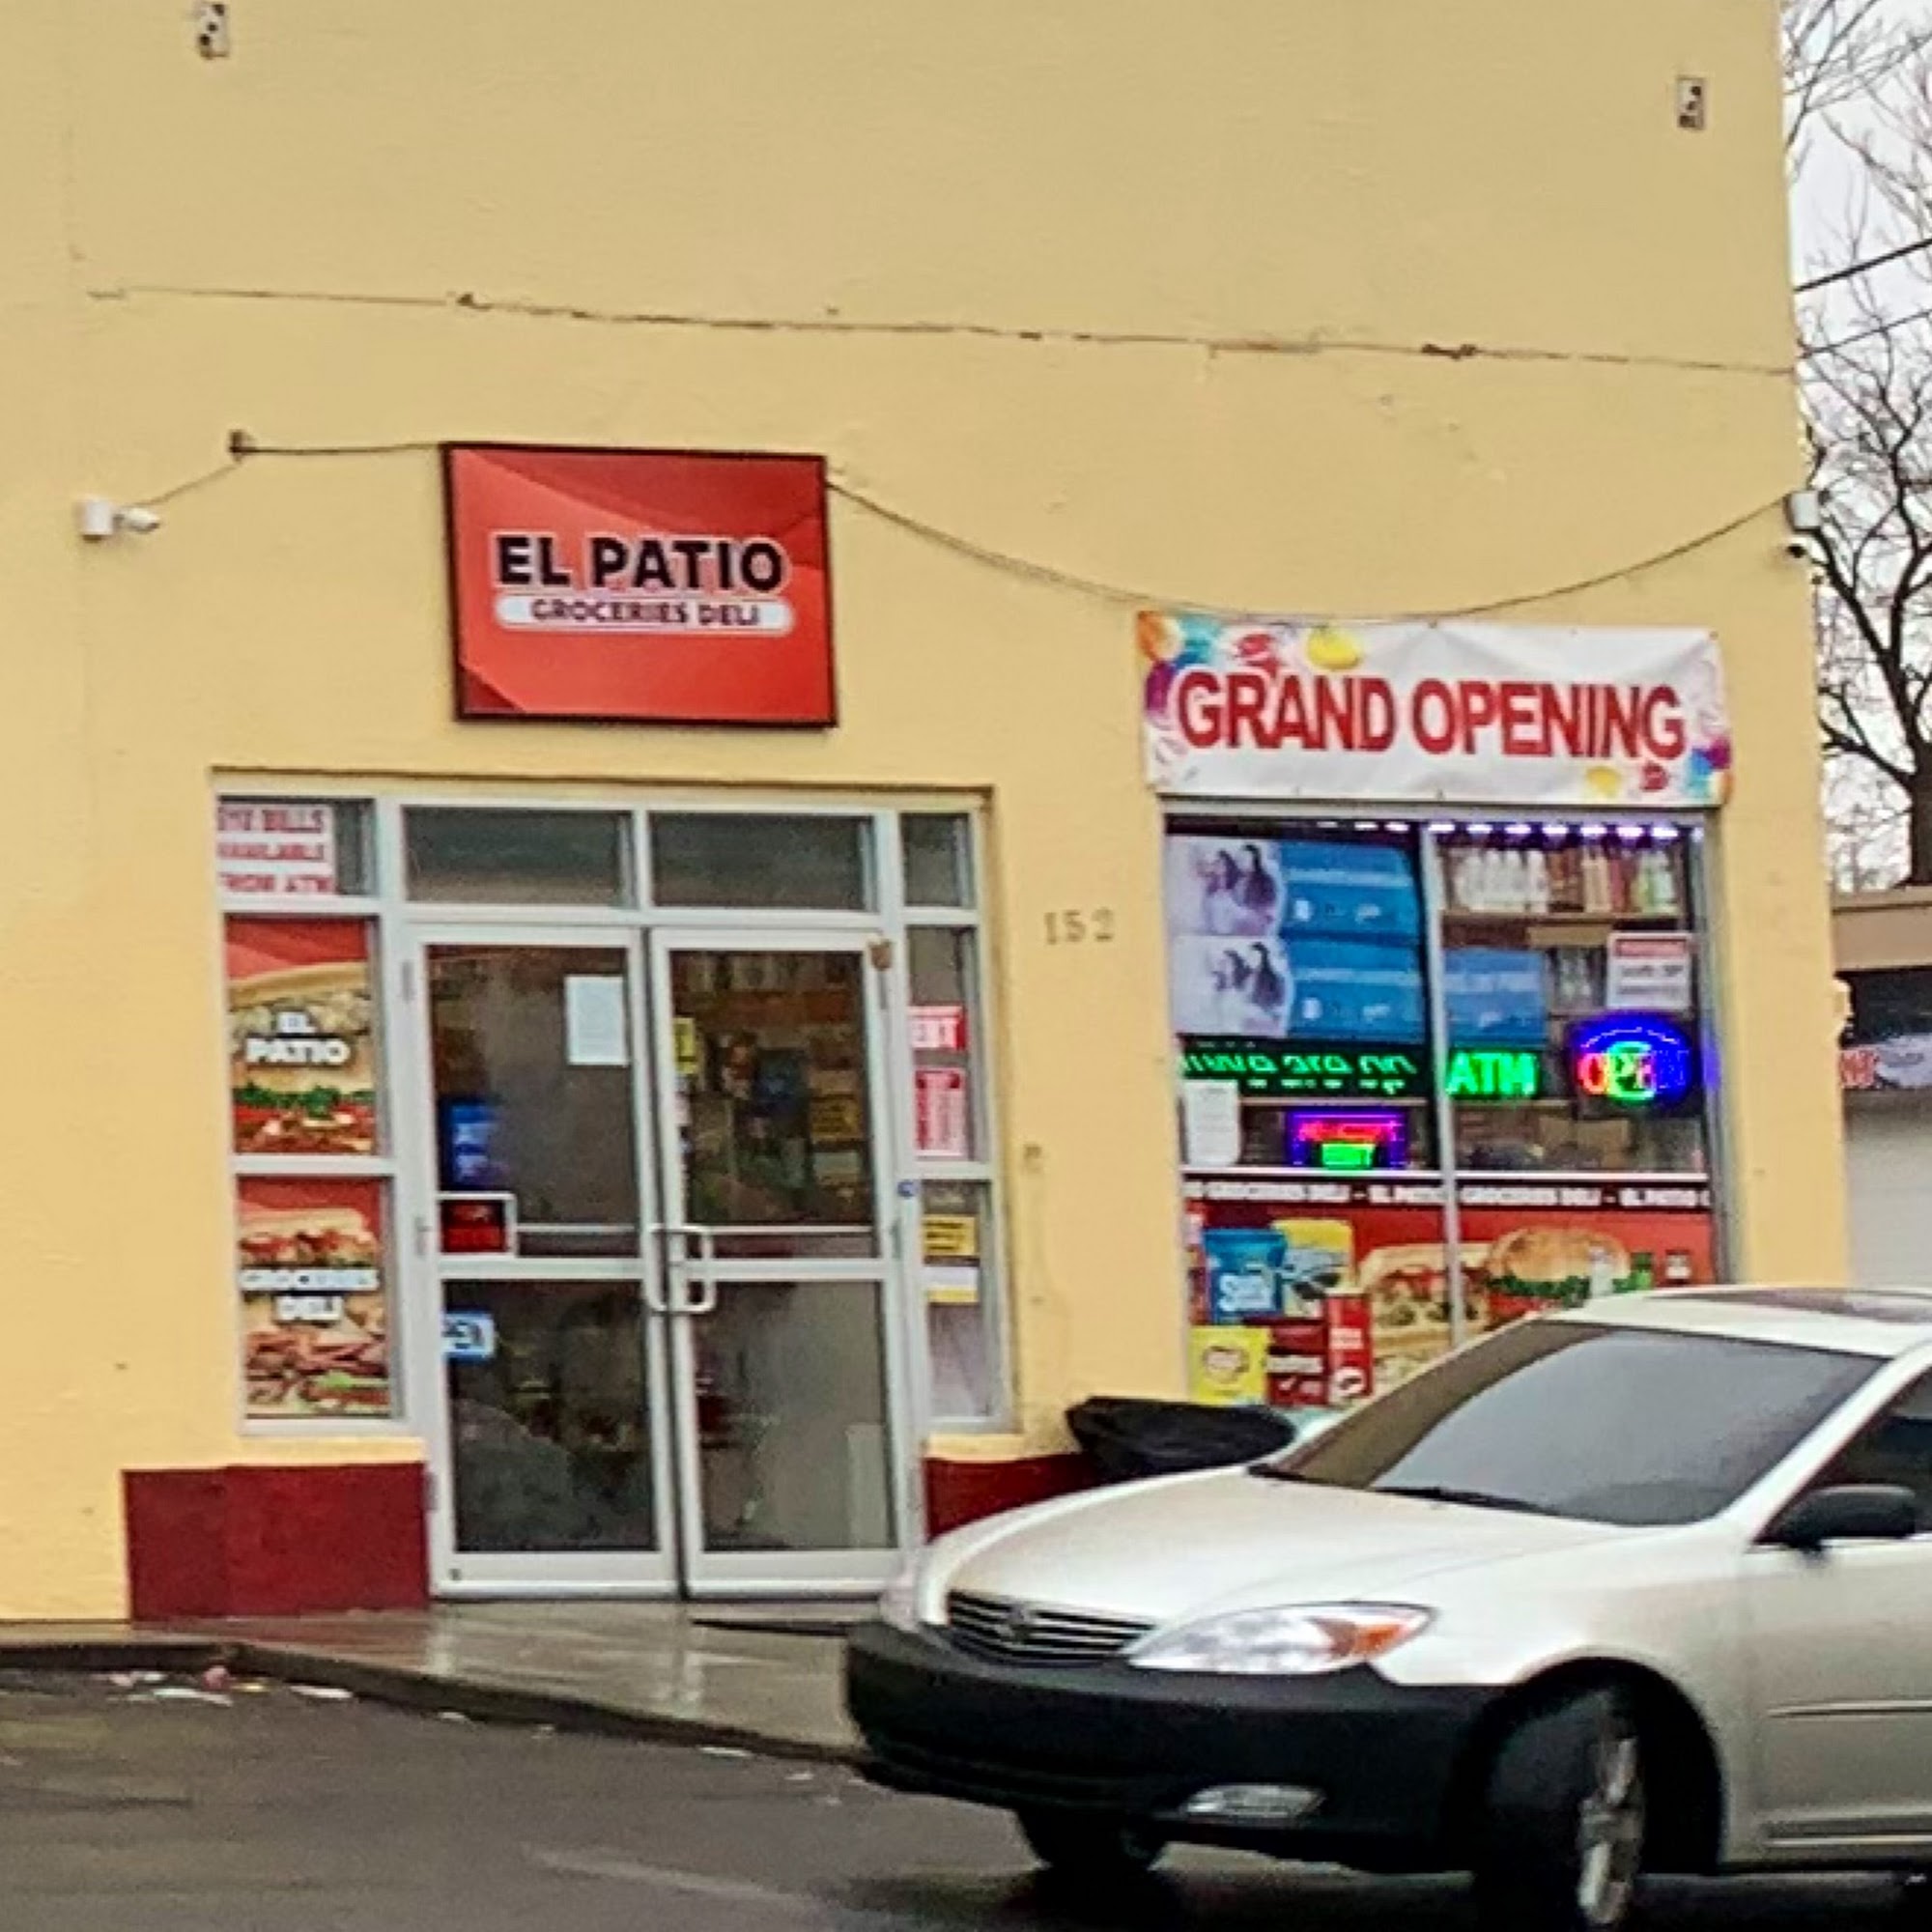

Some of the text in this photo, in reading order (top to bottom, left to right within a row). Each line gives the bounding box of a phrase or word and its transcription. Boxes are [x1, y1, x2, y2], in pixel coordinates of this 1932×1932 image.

[492, 533, 784, 593] EL PATIO
[530, 597, 759, 628] GROCERIES DELI
[1178, 670, 1687, 761] GRAND OPENING
[1043, 907, 1116, 946] 152
[1445, 1050, 1539, 1097] ATM
